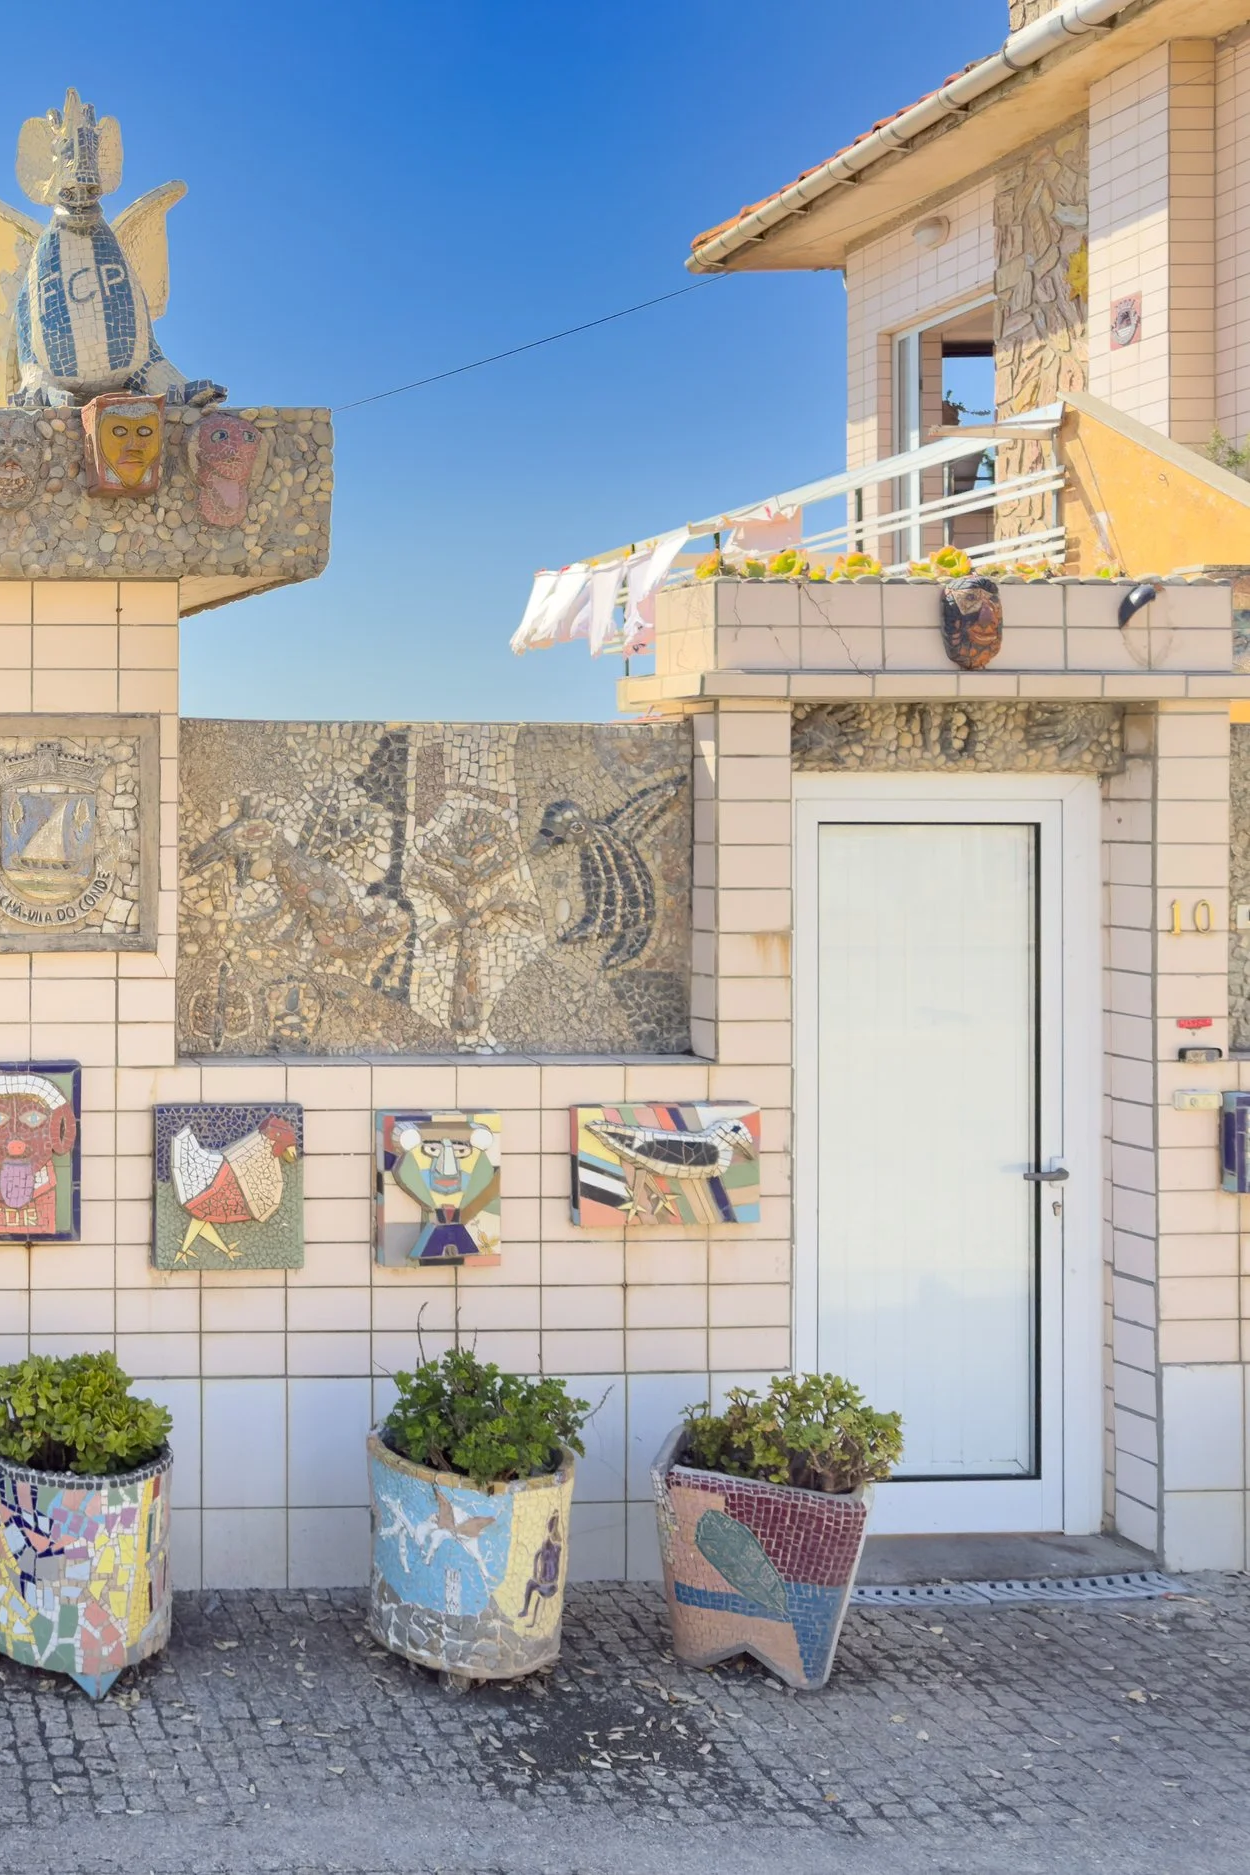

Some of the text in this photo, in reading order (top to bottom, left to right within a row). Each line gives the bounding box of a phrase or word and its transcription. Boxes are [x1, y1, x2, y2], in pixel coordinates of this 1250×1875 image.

[40, 264, 125, 314] FCP
[57, 906, 76, 921] DO
[78, 872, 111, 911] CONDE
[1169, 897, 1214, 935] 10
